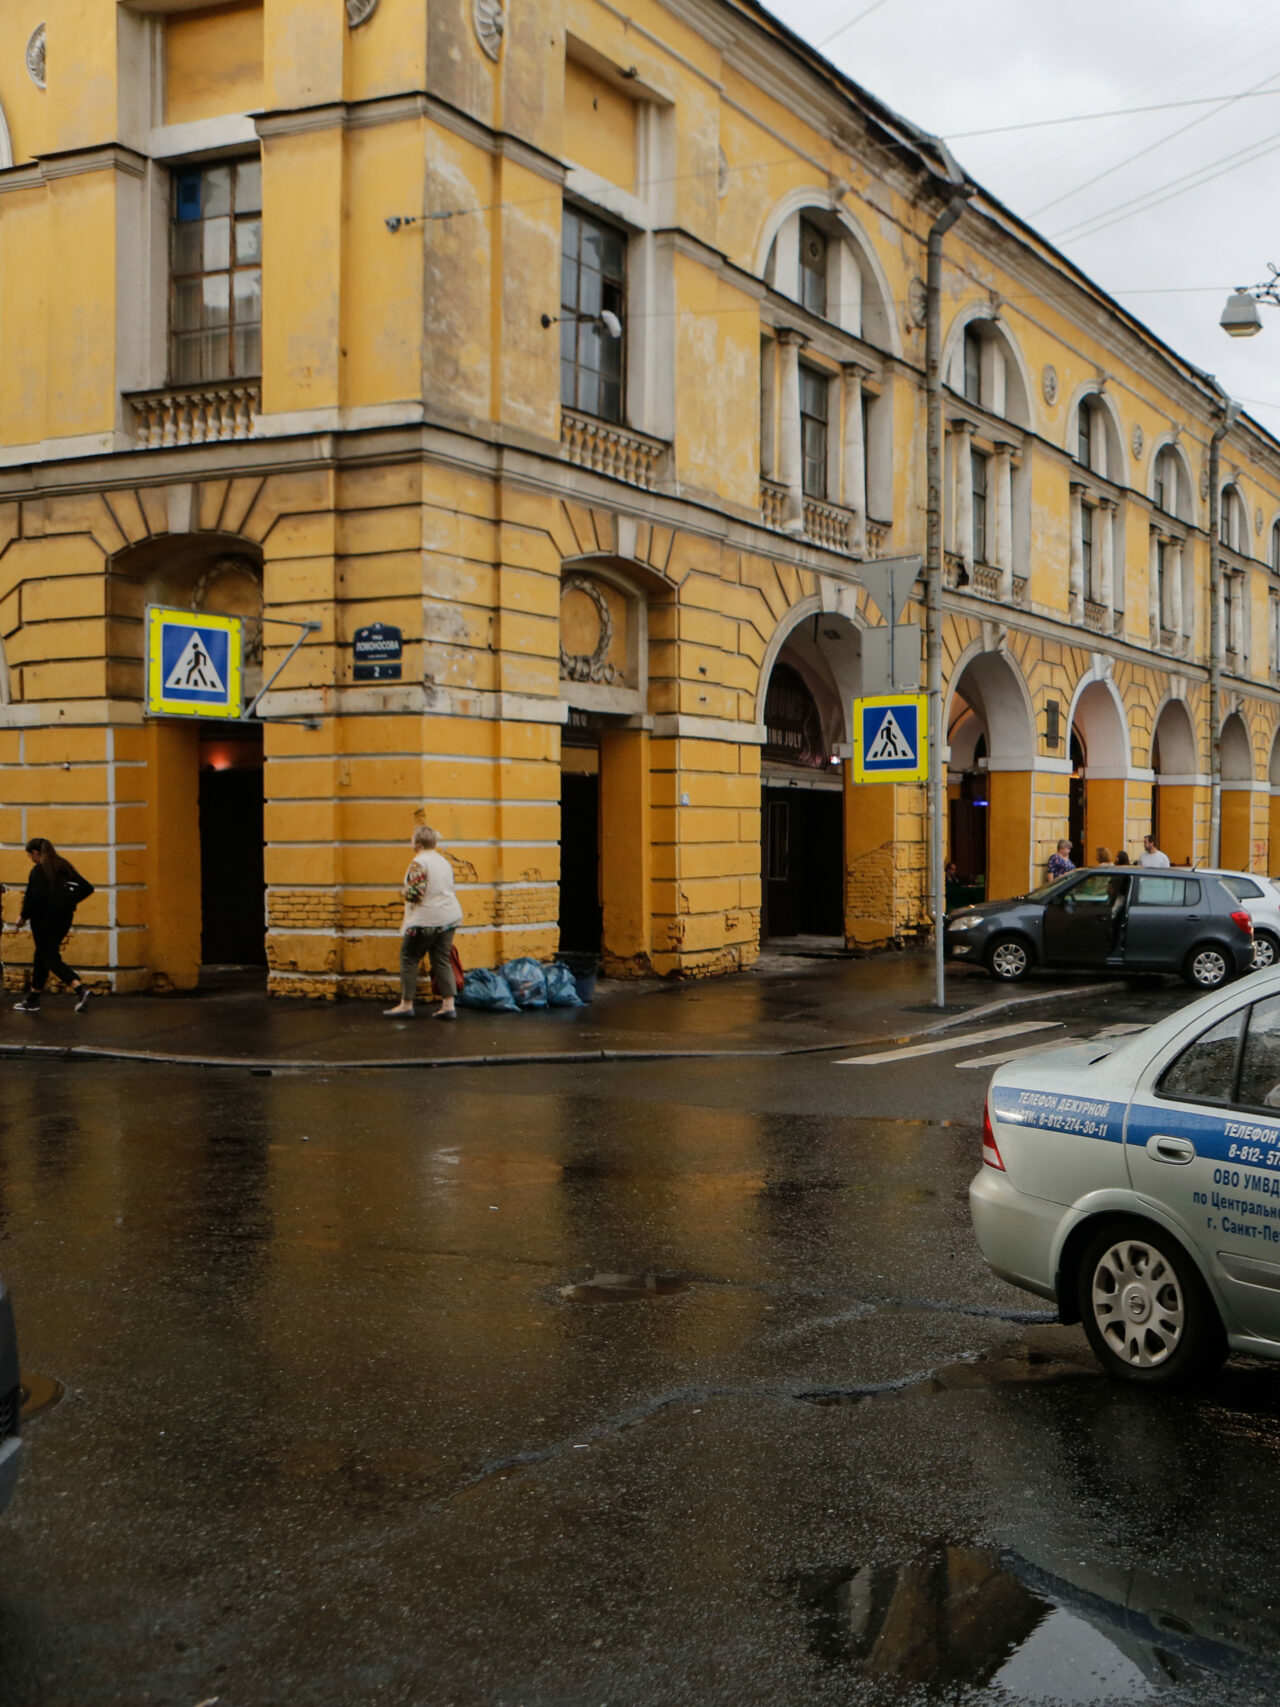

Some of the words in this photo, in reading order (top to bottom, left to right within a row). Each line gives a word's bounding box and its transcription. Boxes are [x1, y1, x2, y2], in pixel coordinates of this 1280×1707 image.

[373, 665, 381, 678] 2
[1019, 1092, 1059, 1109] ТЕЛЕФОН
[1056, 1098, 1111, 1118] ДЕЖУРНОЙ
[1038, 1113, 1109, 1137] 8-812-274-30-11
[1223, 1122, 1280, 1145] ТЕЛЕФОН
[1228, 1143, 1265, 1163] 8-812-
[1213, 1168, 1240, 1188] ОВО
[1243, 1173, 1280, 1198] УМВД
[1192, 1191, 1208, 1206] по
[1206, 1216, 1217, 1231] г.
